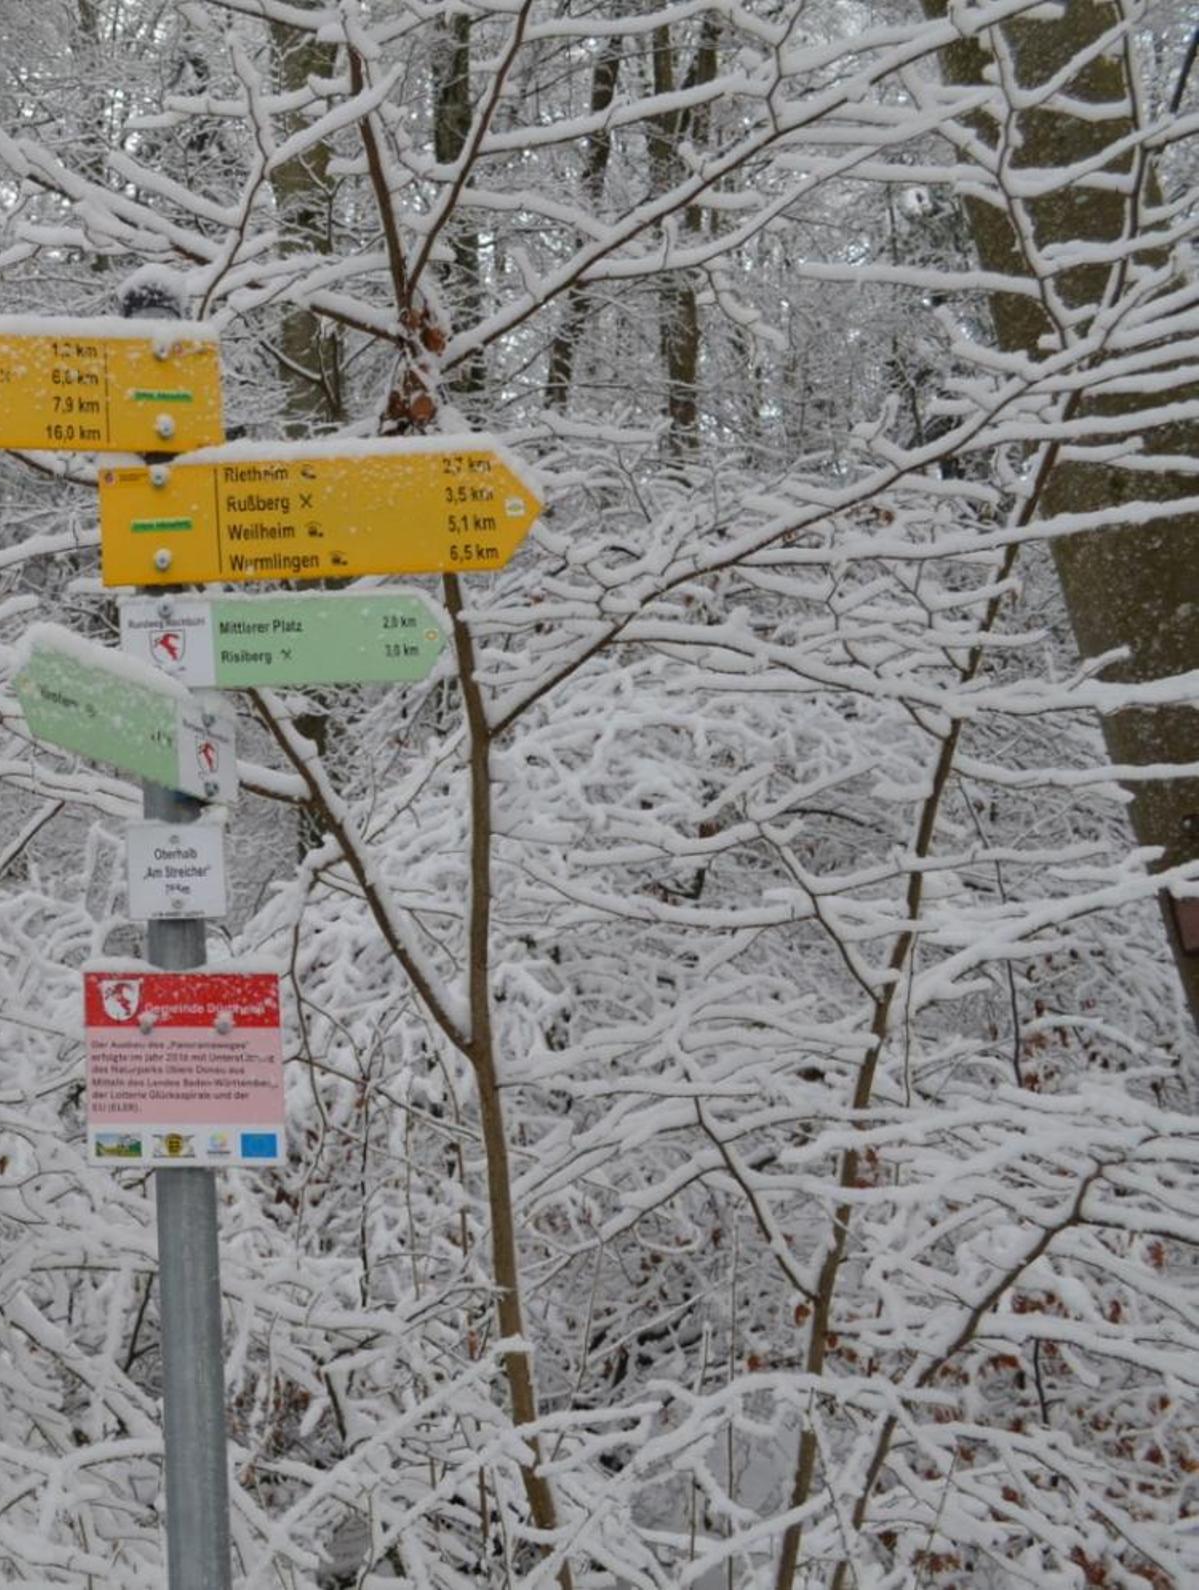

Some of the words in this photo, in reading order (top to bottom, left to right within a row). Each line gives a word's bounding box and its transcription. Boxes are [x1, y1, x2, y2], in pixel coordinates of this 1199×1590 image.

[75, 342, 98, 358] km
[77, 369, 99, 386] km
[52, 396, 74, 414] 7,9
[78, 397, 100, 413] km
[46, 424, 75, 442] 16,0
[79, 425, 101, 441] km
[223, 465, 289, 482] Rietheim
[442, 456, 463, 475] 2,7
[468, 456, 492, 473] km
[226, 494, 290, 514] Rußberg
[445, 486, 467, 505] 3,5
[471, 486, 494, 501] km
[227, 523, 296, 540] Weilheim
[448, 514, 469, 534] 5,1
[473, 514, 497, 531] km
[449, 543, 473, 562] 6,5
[475, 543, 500, 559] km
[229, 553, 320, 573] Wurmlingen
[272, 618, 304, 633] Platz
[400, 615, 417, 628] km
[403, 643, 420, 657] km
